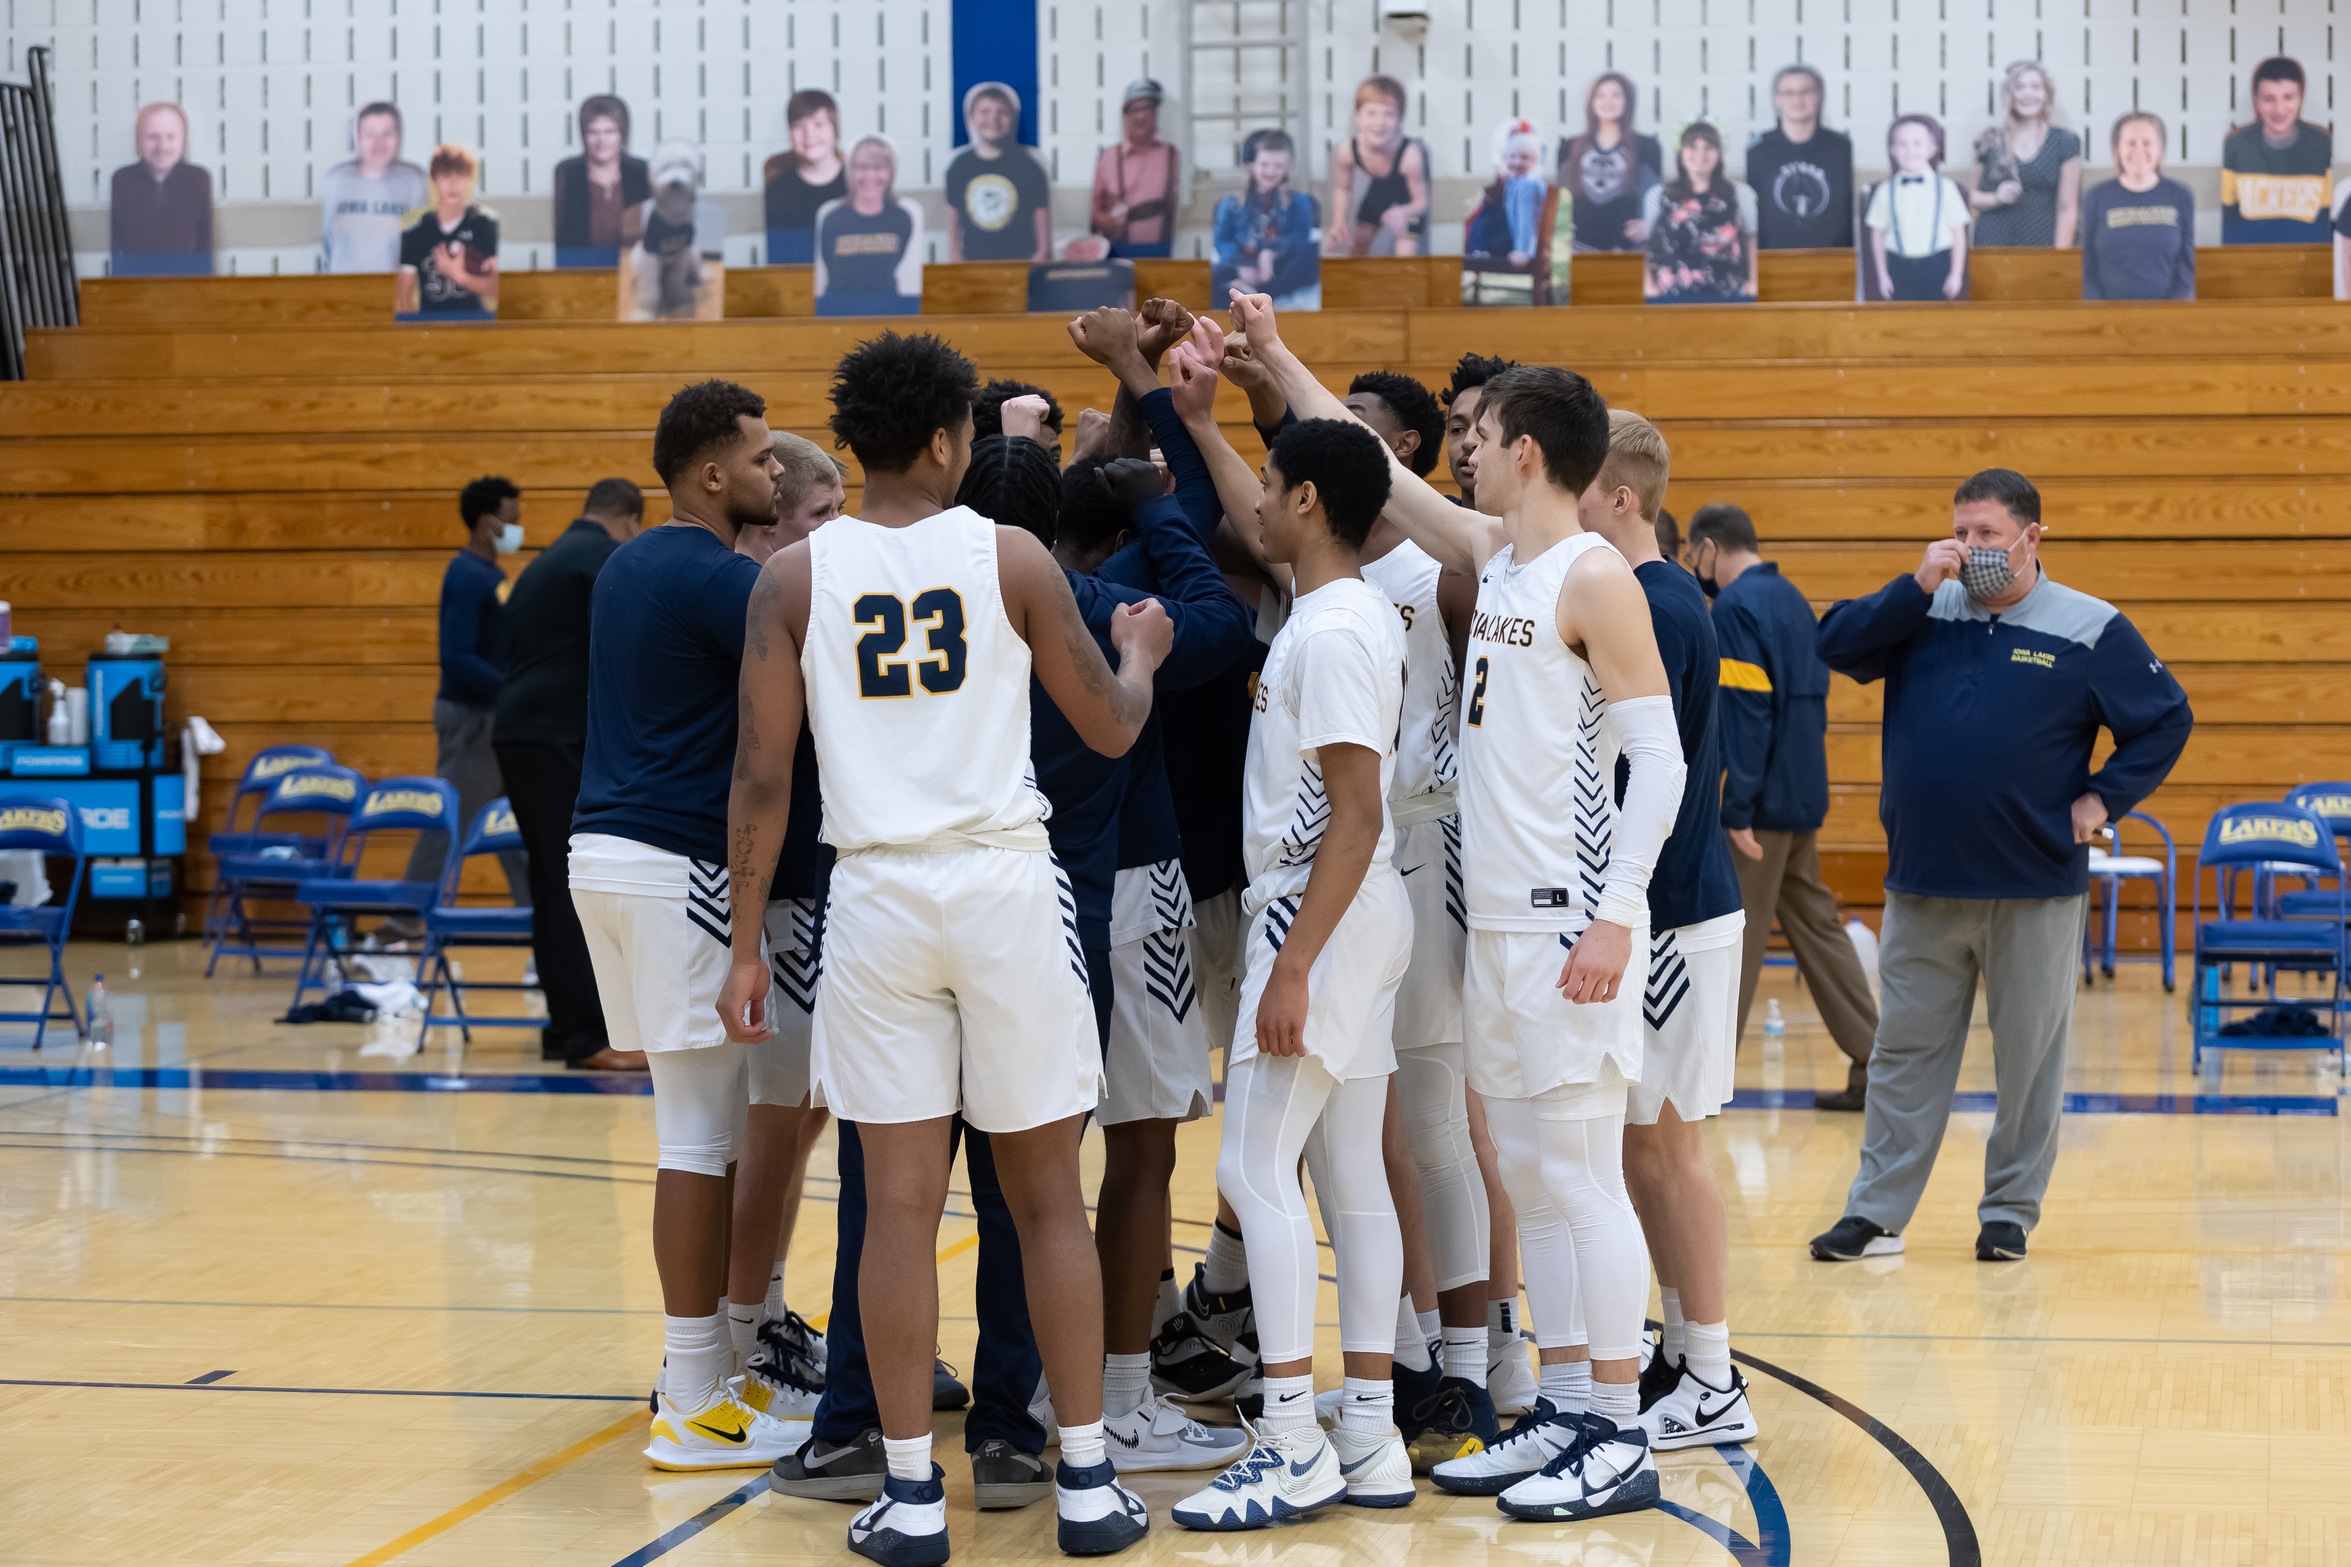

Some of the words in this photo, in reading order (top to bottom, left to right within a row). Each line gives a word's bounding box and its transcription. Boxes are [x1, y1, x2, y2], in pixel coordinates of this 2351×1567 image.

[851, 585, 968, 700] 23
[2012, 647, 2031, 657] IOWA
[2033, 650, 2056, 662] LAKES
[2011, 654, 2053, 668] BASKETBALL
[1467, 655, 1489, 729] 2
[0, 807, 67, 836] AKERS
[2219, 815, 2318, 848] LAKERS
[1556, 893, 1563, 902] L
